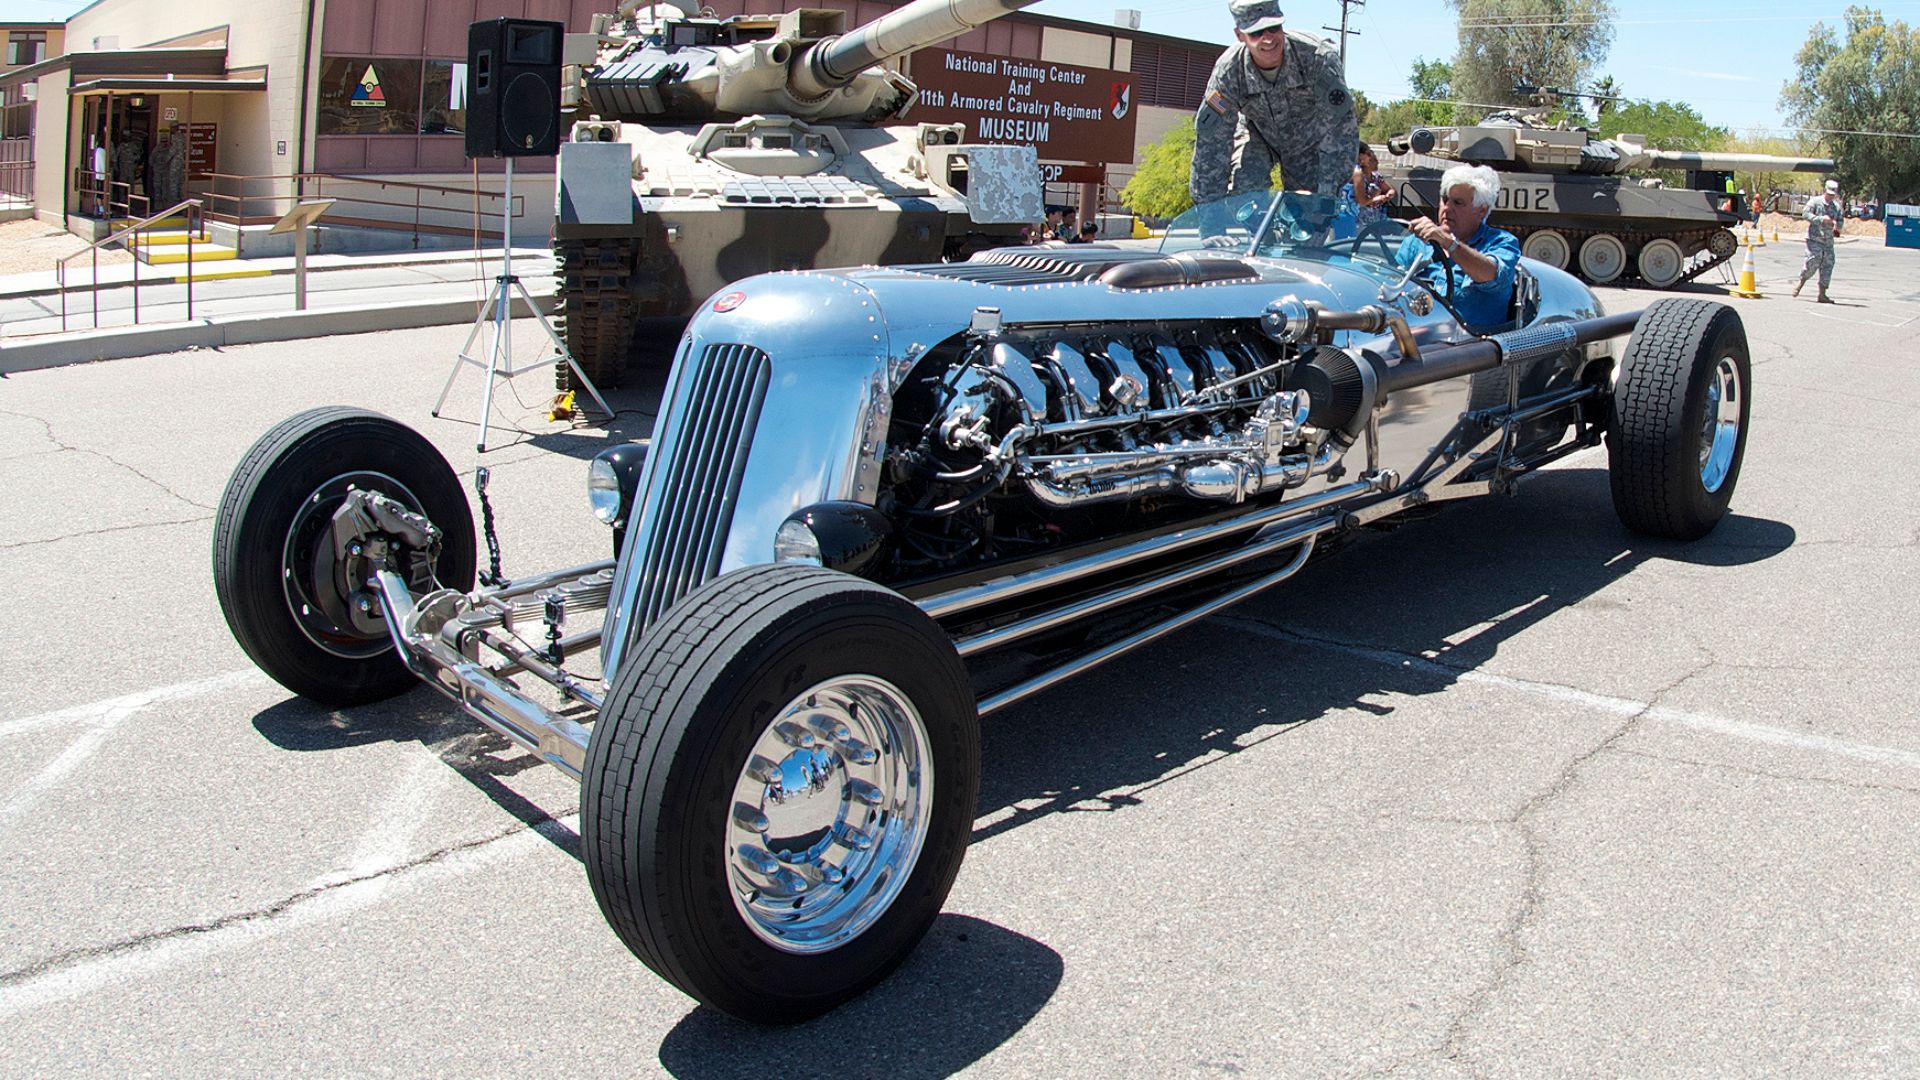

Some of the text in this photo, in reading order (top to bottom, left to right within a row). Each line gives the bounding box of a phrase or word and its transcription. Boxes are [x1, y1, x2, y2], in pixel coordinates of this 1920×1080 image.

[945, 53, 1086, 84] National Training Center
[1008, 79, 1031, 96] And
[920, 89, 1103, 120] 11th Armored Cavalry Regiment
[979, 117, 1049, 142] MUSEUM
